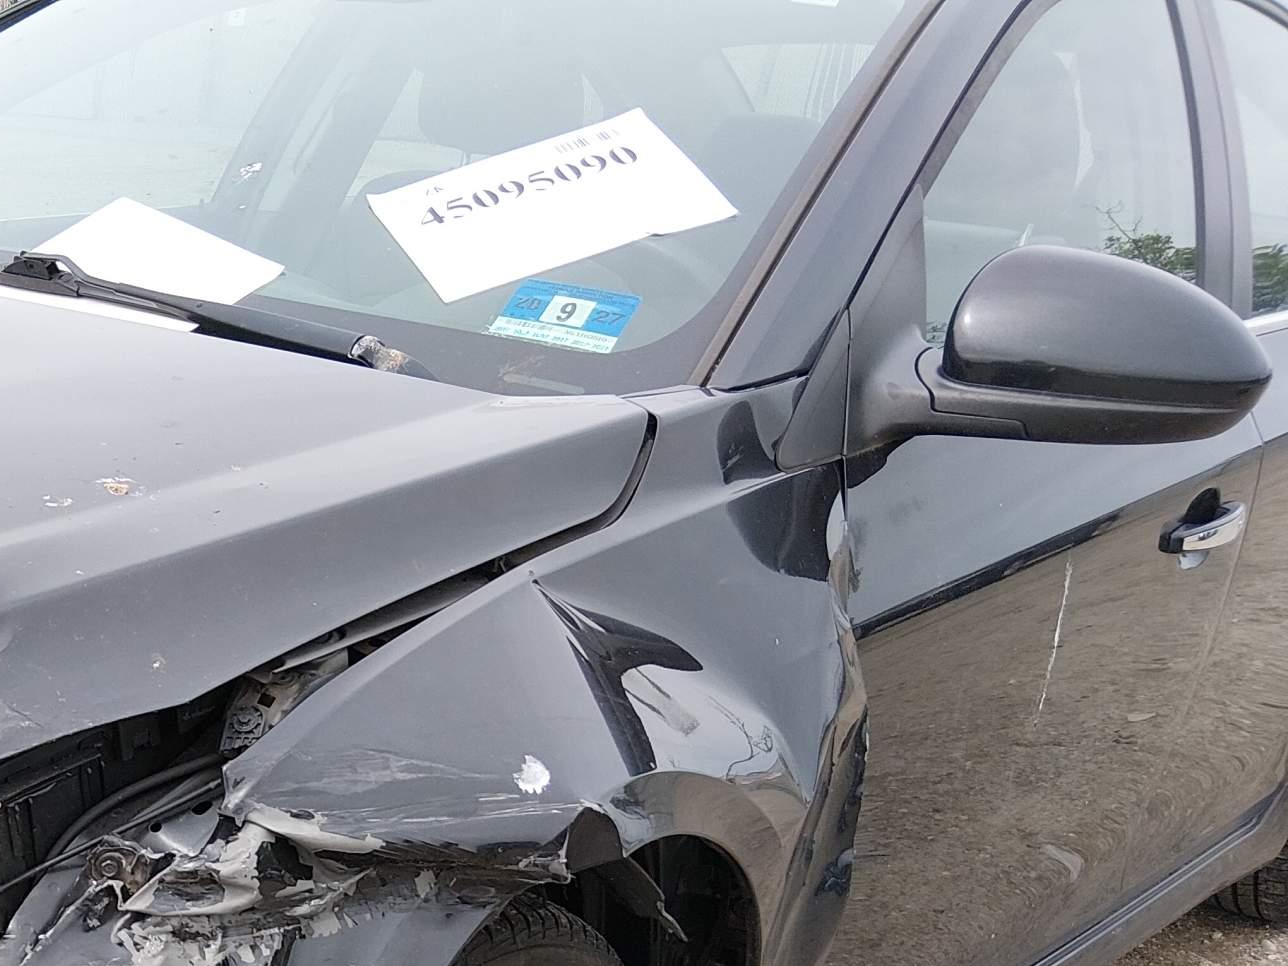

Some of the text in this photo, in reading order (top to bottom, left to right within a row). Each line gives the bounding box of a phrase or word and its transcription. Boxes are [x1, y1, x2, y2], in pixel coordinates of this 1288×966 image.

[420, 146, 638, 225] 45095090
[556, 302, 577, 323] 9
[592, 311, 625, 325] 27
